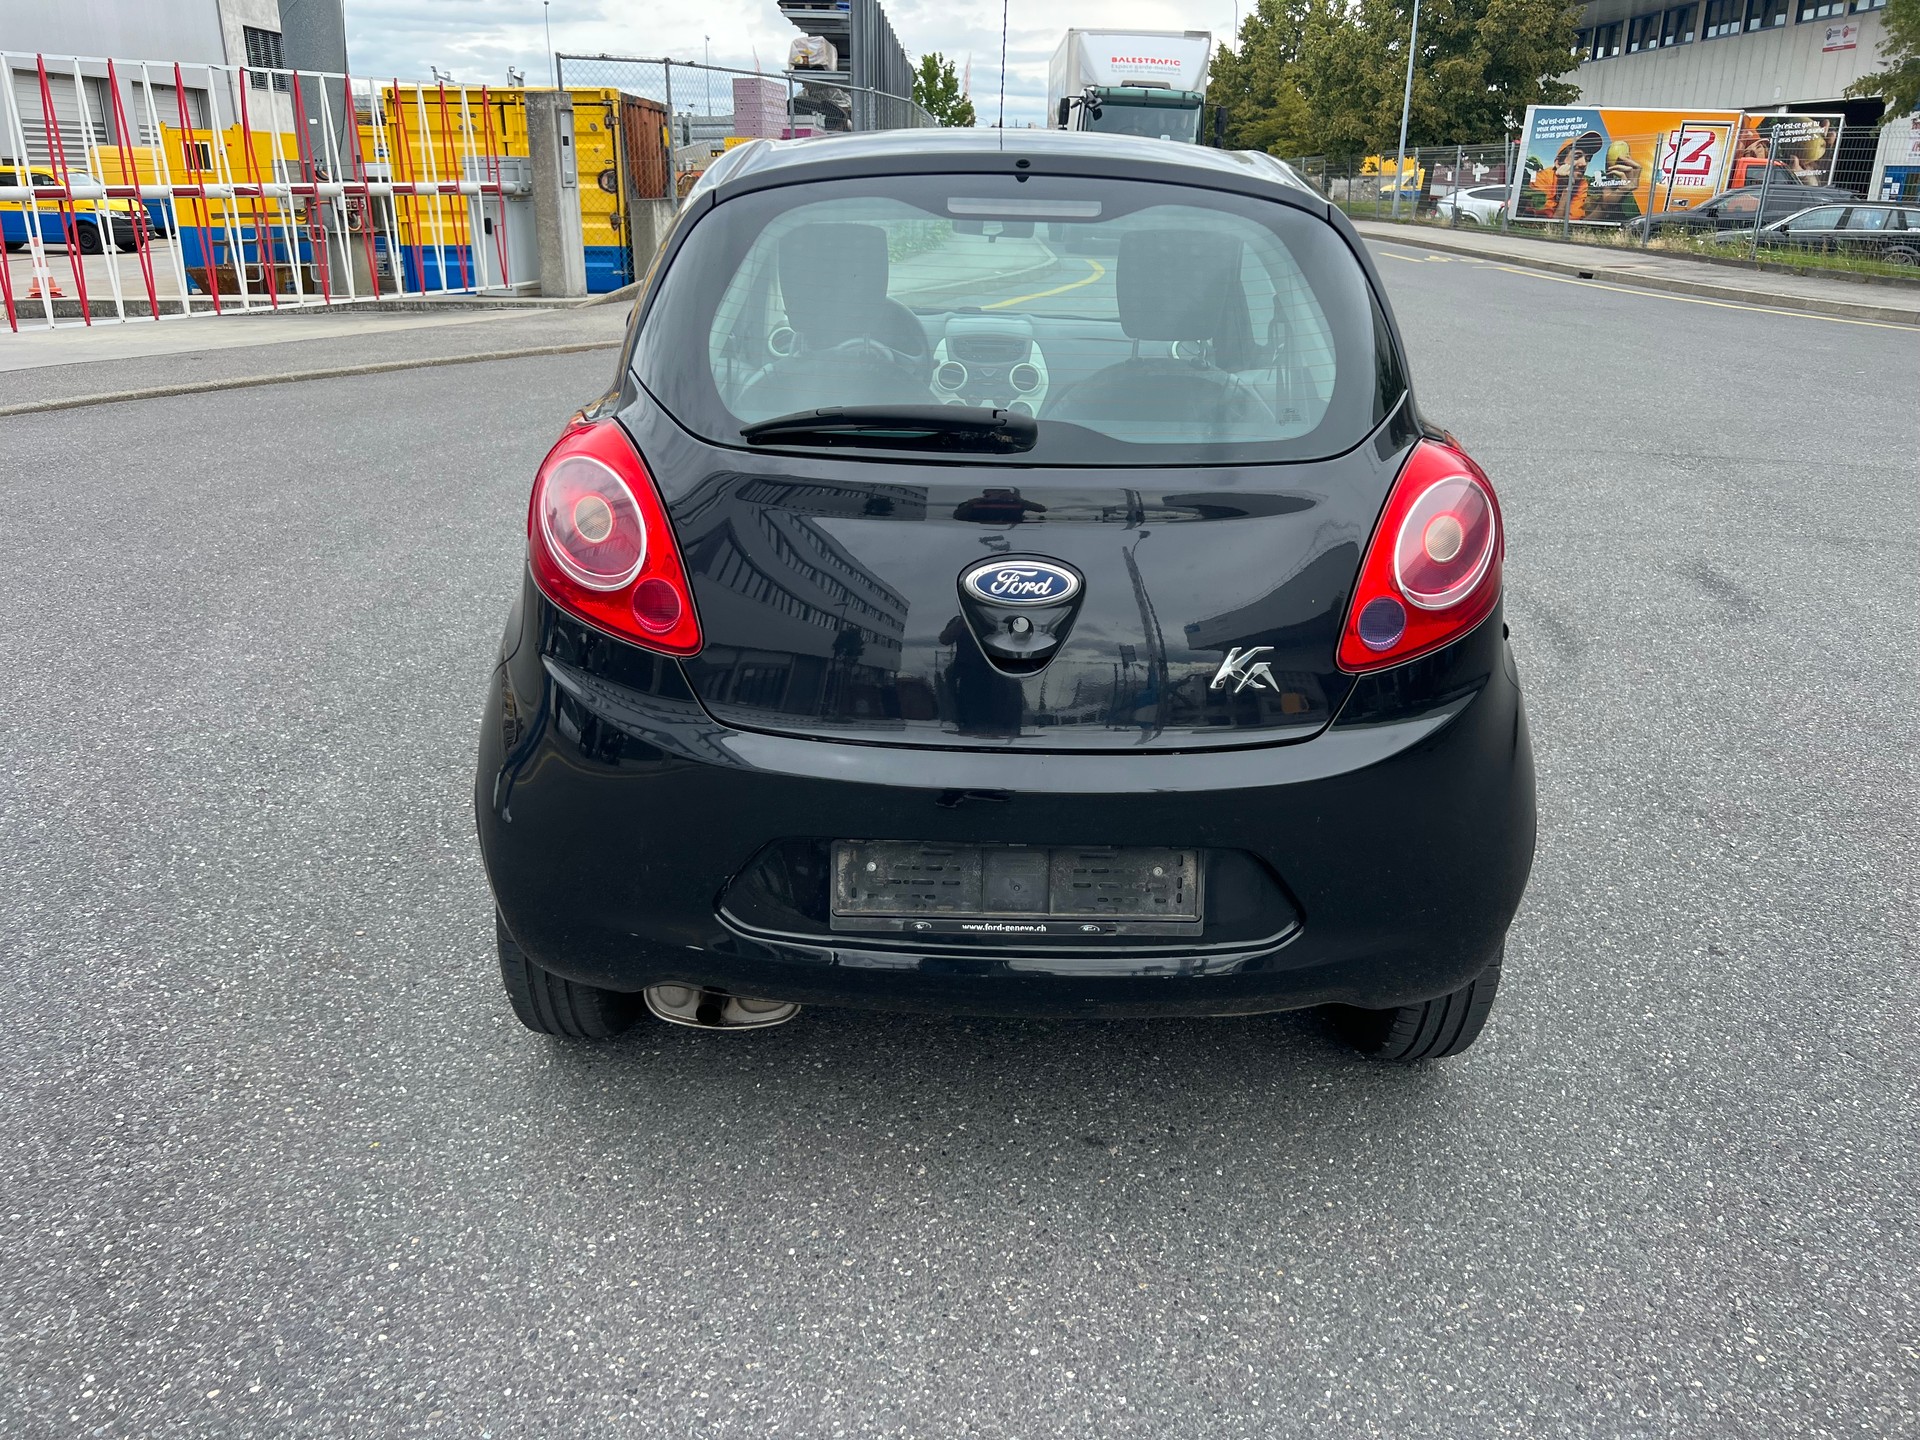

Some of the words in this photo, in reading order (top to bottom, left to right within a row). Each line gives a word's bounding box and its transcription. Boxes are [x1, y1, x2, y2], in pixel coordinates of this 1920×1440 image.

[1111, 57, 1181, 66] BALESTRAFIC
[1791, 134, 1811, 143] grande
[991, 569, 1054, 595] Ford
[962, 923, 1047, 932] www.ford-geneve.ch
